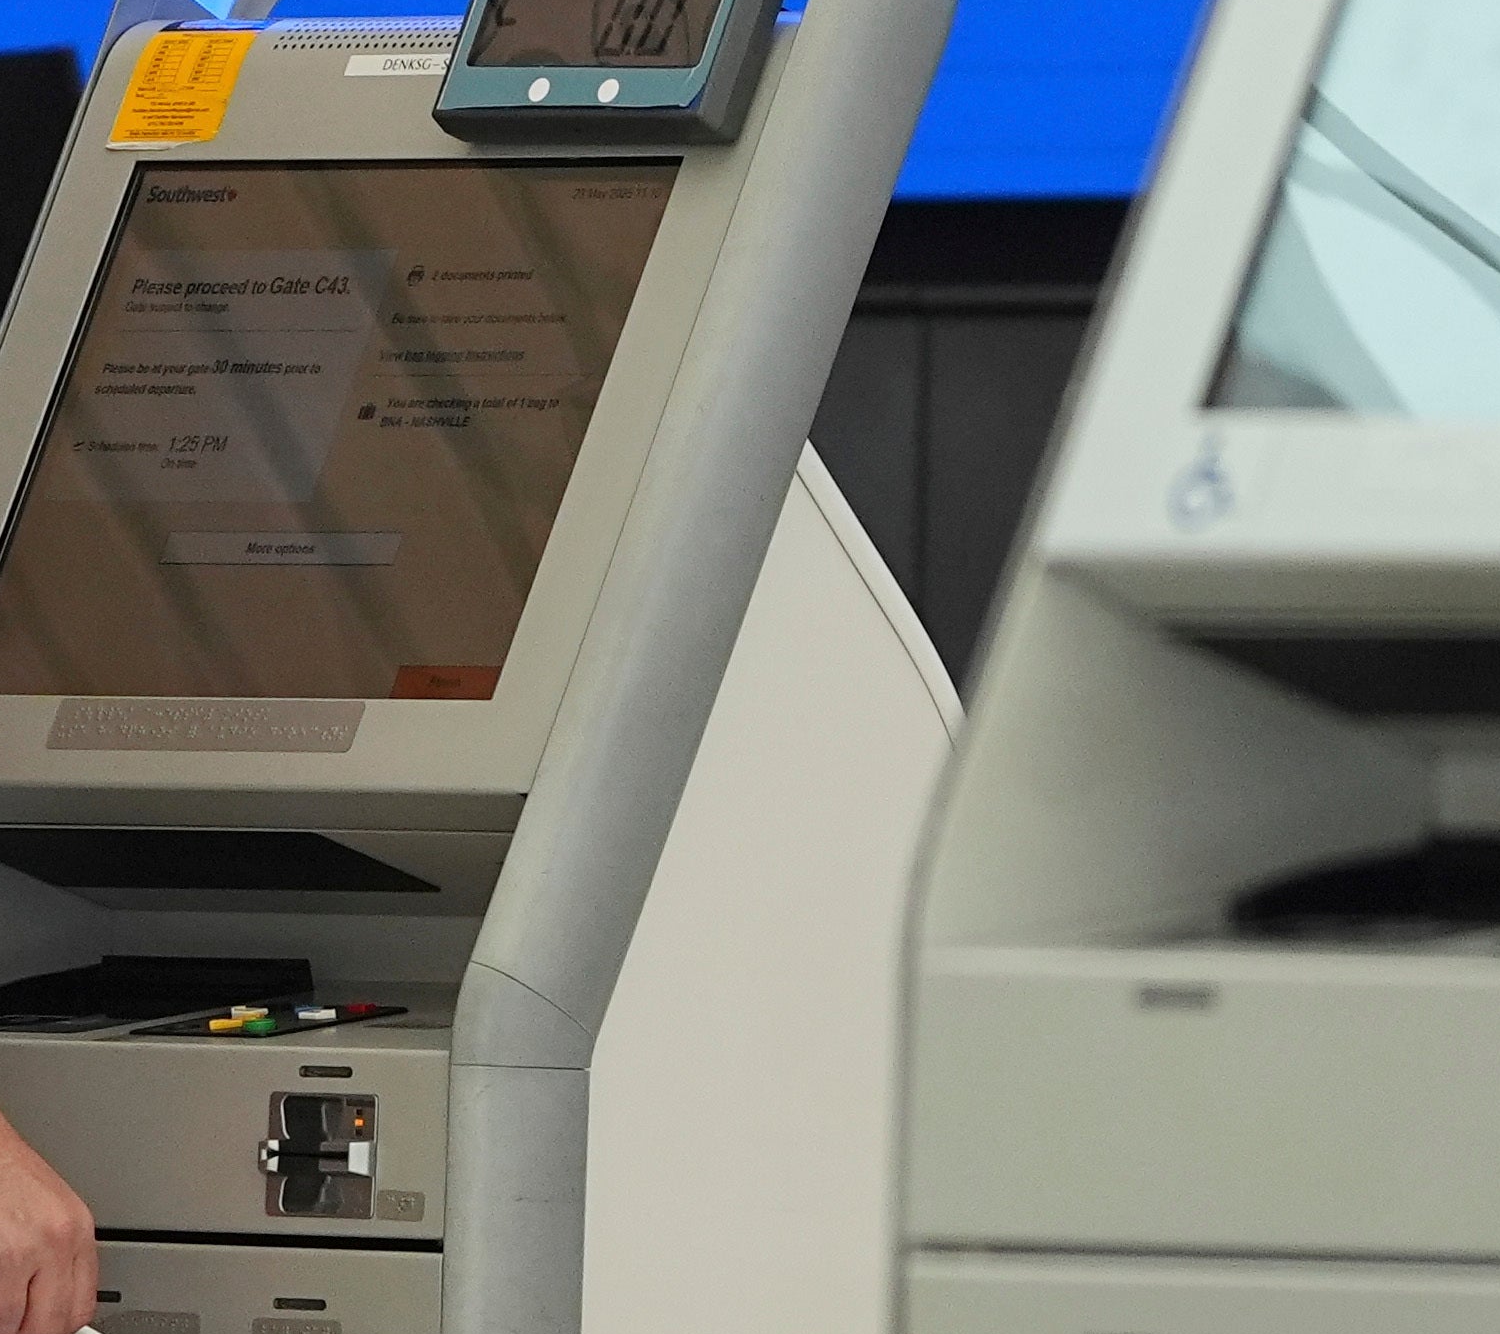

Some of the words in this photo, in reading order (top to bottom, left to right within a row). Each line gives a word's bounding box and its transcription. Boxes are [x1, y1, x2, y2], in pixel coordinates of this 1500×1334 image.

[146, 185, 228, 204] Southwest
[441, 269, 495, 281] documents
[132, 279, 183, 296] Please
[184, 280, 250, 299] proceed
[251, 280, 268, 295] to
[270, 276, 311, 296] Gate
[314, 276, 351, 295] C43.
[103, 363, 135, 374] Please
[136, 363, 150, 374] be
[162, 365, 187, 376] your
[187, 365, 210, 376] gate
[212, 359, 229, 374] 30
[230, 359, 283, 375] minutes
[284, 365, 308, 376] prior
[309, 365, 321, 374] to
[95, 384, 148, 396] scheduled
[388, 398, 407, 409] You
[408, 400, 426, 409] are
[426, 398, 472, 411] checking
[482, 398, 506, 409] total
[506, 398, 519, 409] of
[527, 398, 547, 411] bag
[548, 398, 560, 409] to
[411, 416, 471, 428] NASHVILLE
[169, 436, 200, 453] 1:25
[201, 436, 228, 453] PM
[246, 542, 273, 554] More
[274, 544, 315, 557] options
